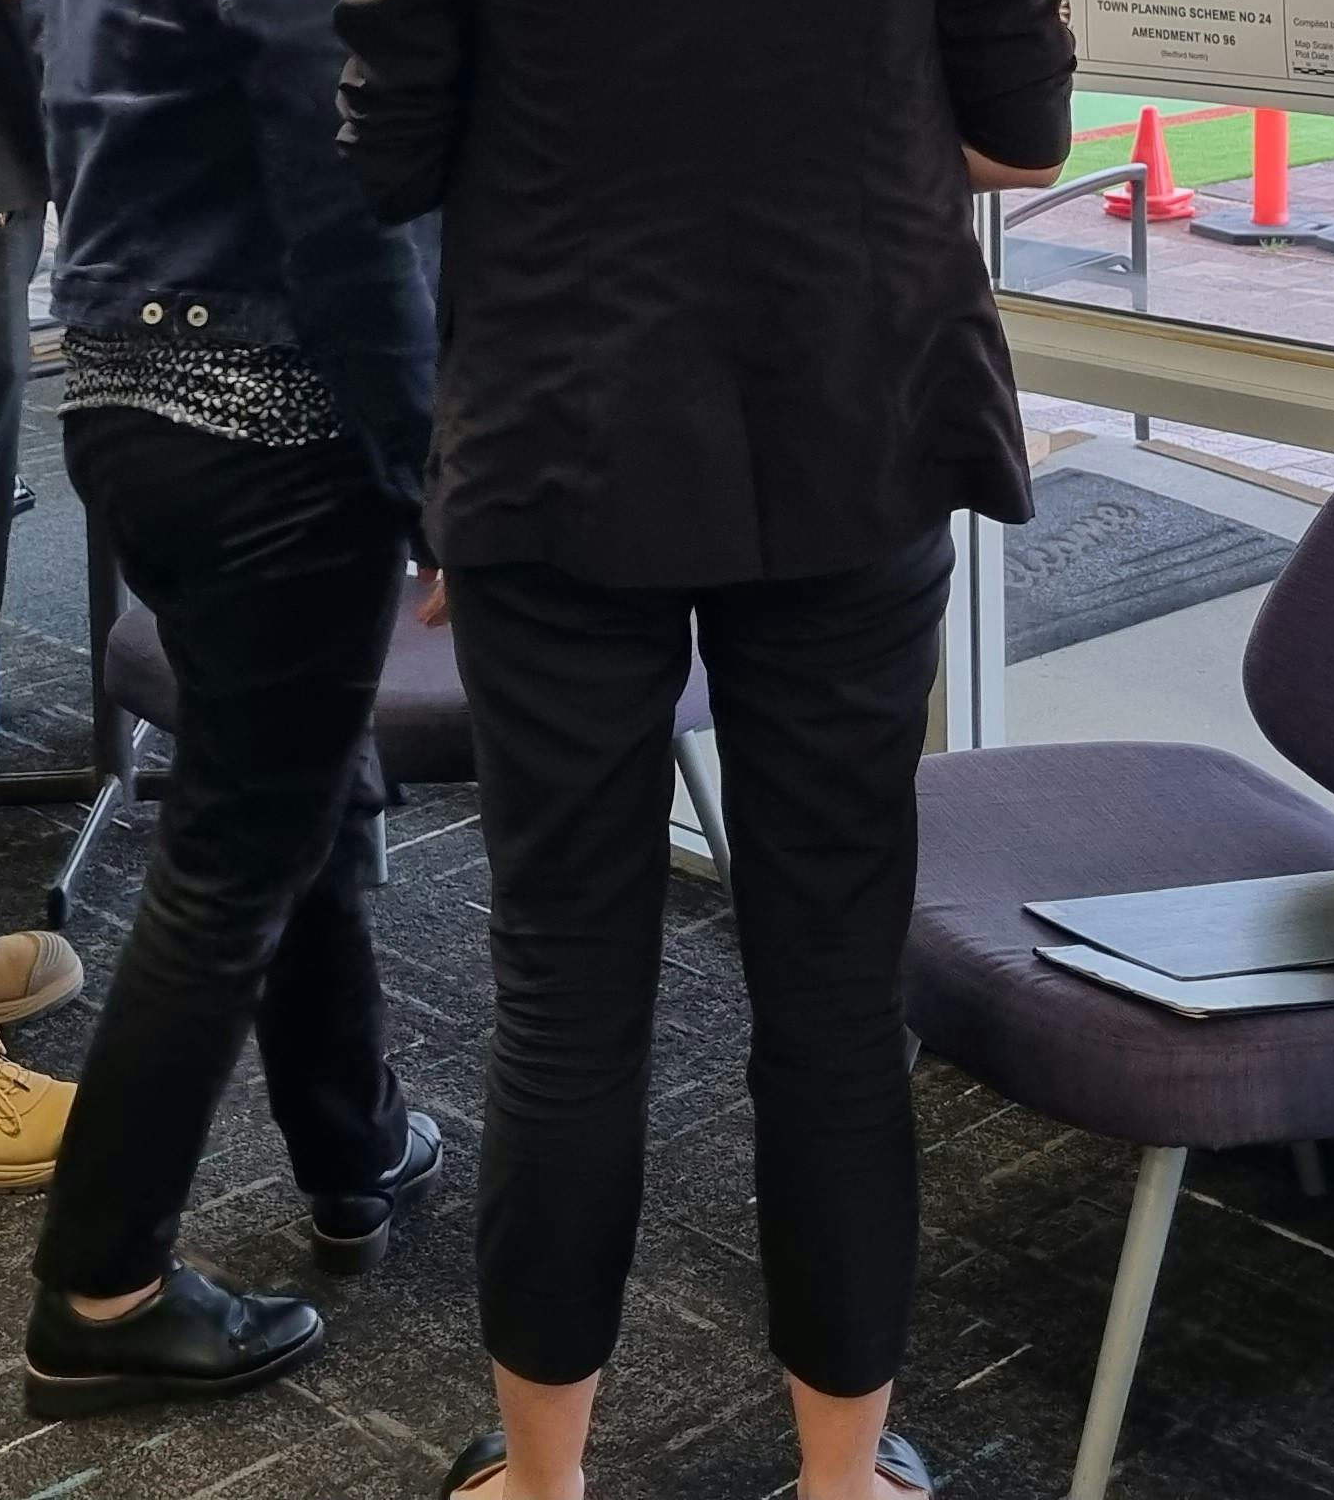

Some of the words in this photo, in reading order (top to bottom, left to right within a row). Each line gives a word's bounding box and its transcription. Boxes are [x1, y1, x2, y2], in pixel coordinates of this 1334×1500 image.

[1097, 0, 1128, 13] TOWN
[1131, 3, 1186, 18] PLANNING
[1189, 6, 1235, 21] SCHEME
[1239, 12, 1255, 23] NO
[1259, 13, 1272, 24] 24
[1293, 17, 1328, 29] Compiled
[1132, 27, 1200, 43] AMENDMENT
[1204, 33, 1220, 44] NO
[1223, 34, 1235, 45] 96
[1295, 40, 1310, 49] Map
[1312, 41, 1334, 51] Scale
[1311, 51, 1329, 61] Date
